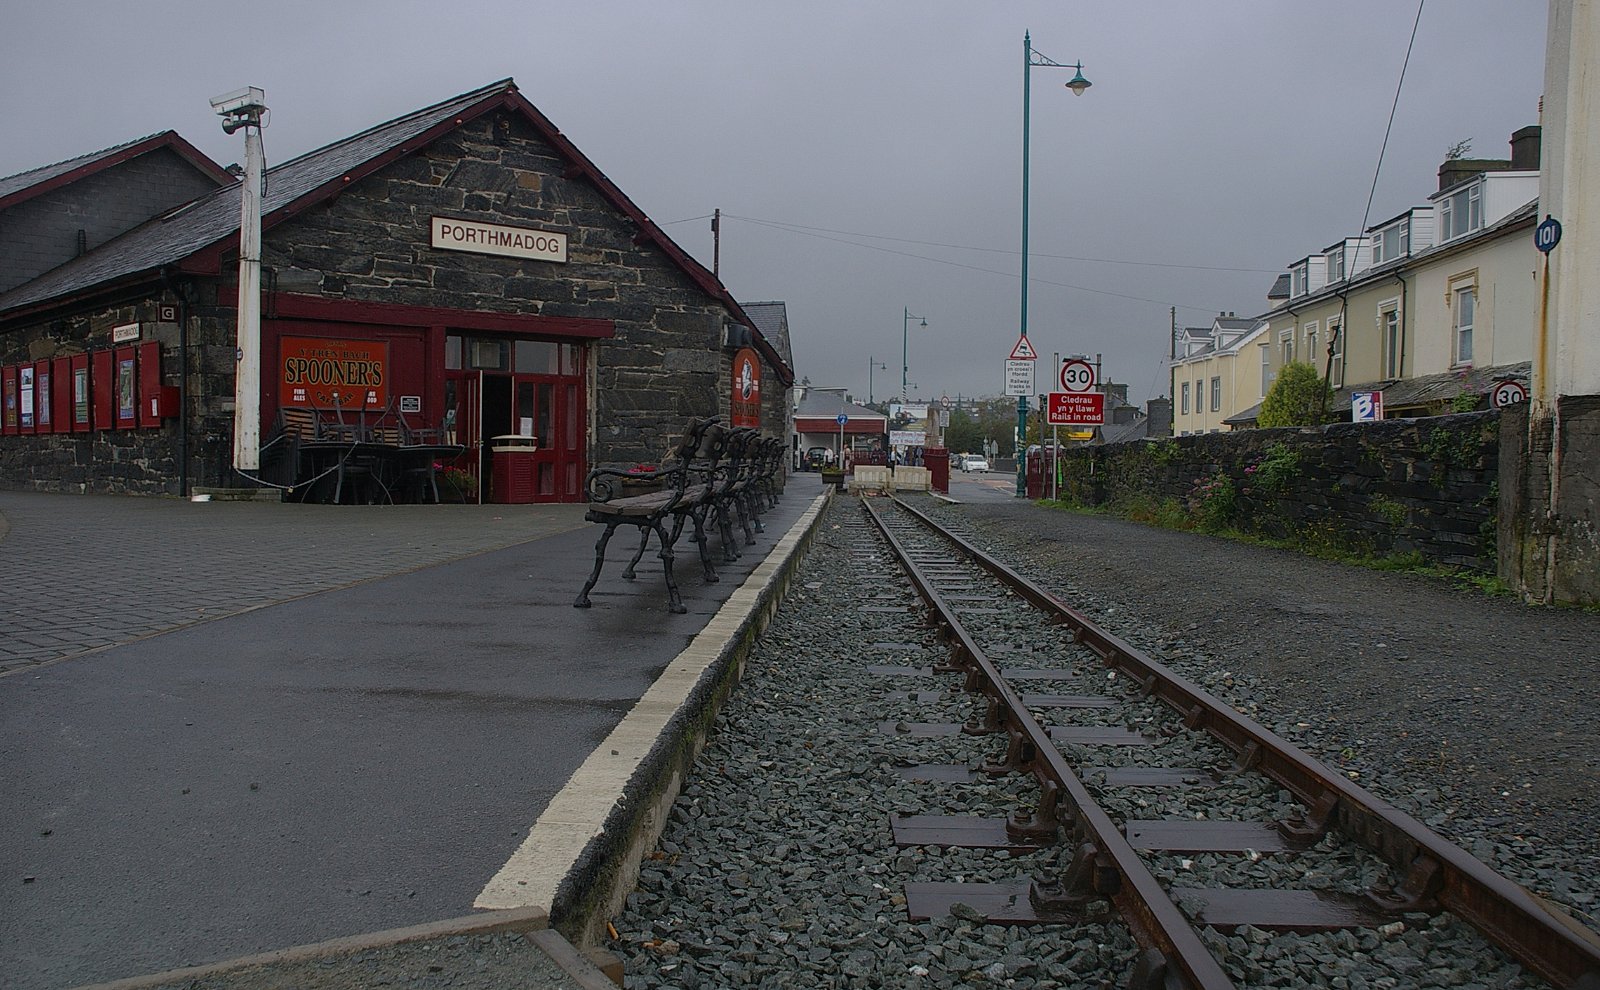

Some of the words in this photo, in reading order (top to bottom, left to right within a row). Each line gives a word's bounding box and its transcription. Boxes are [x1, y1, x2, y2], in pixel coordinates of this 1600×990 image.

[441, 224, 559, 253] PORTHMADOG
[1539, 225, 1555, 246] 101
[163, 309, 173, 318] G
[286, 358, 382, 386] SPOONER'S
[1066, 369, 1089, 384] 30
[1060, 395, 1093, 404] Cledrau
[1499, 389, 1522, 404] 30
[1057, 405, 1067, 413] yn
[1068, 405, 1074, 413] y
[1075, 404, 1096, 413] llawr
[1051, 413, 1072, 421] Rails
[1073, 413, 1081, 421] in
[1082, 413, 1102, 421] road
